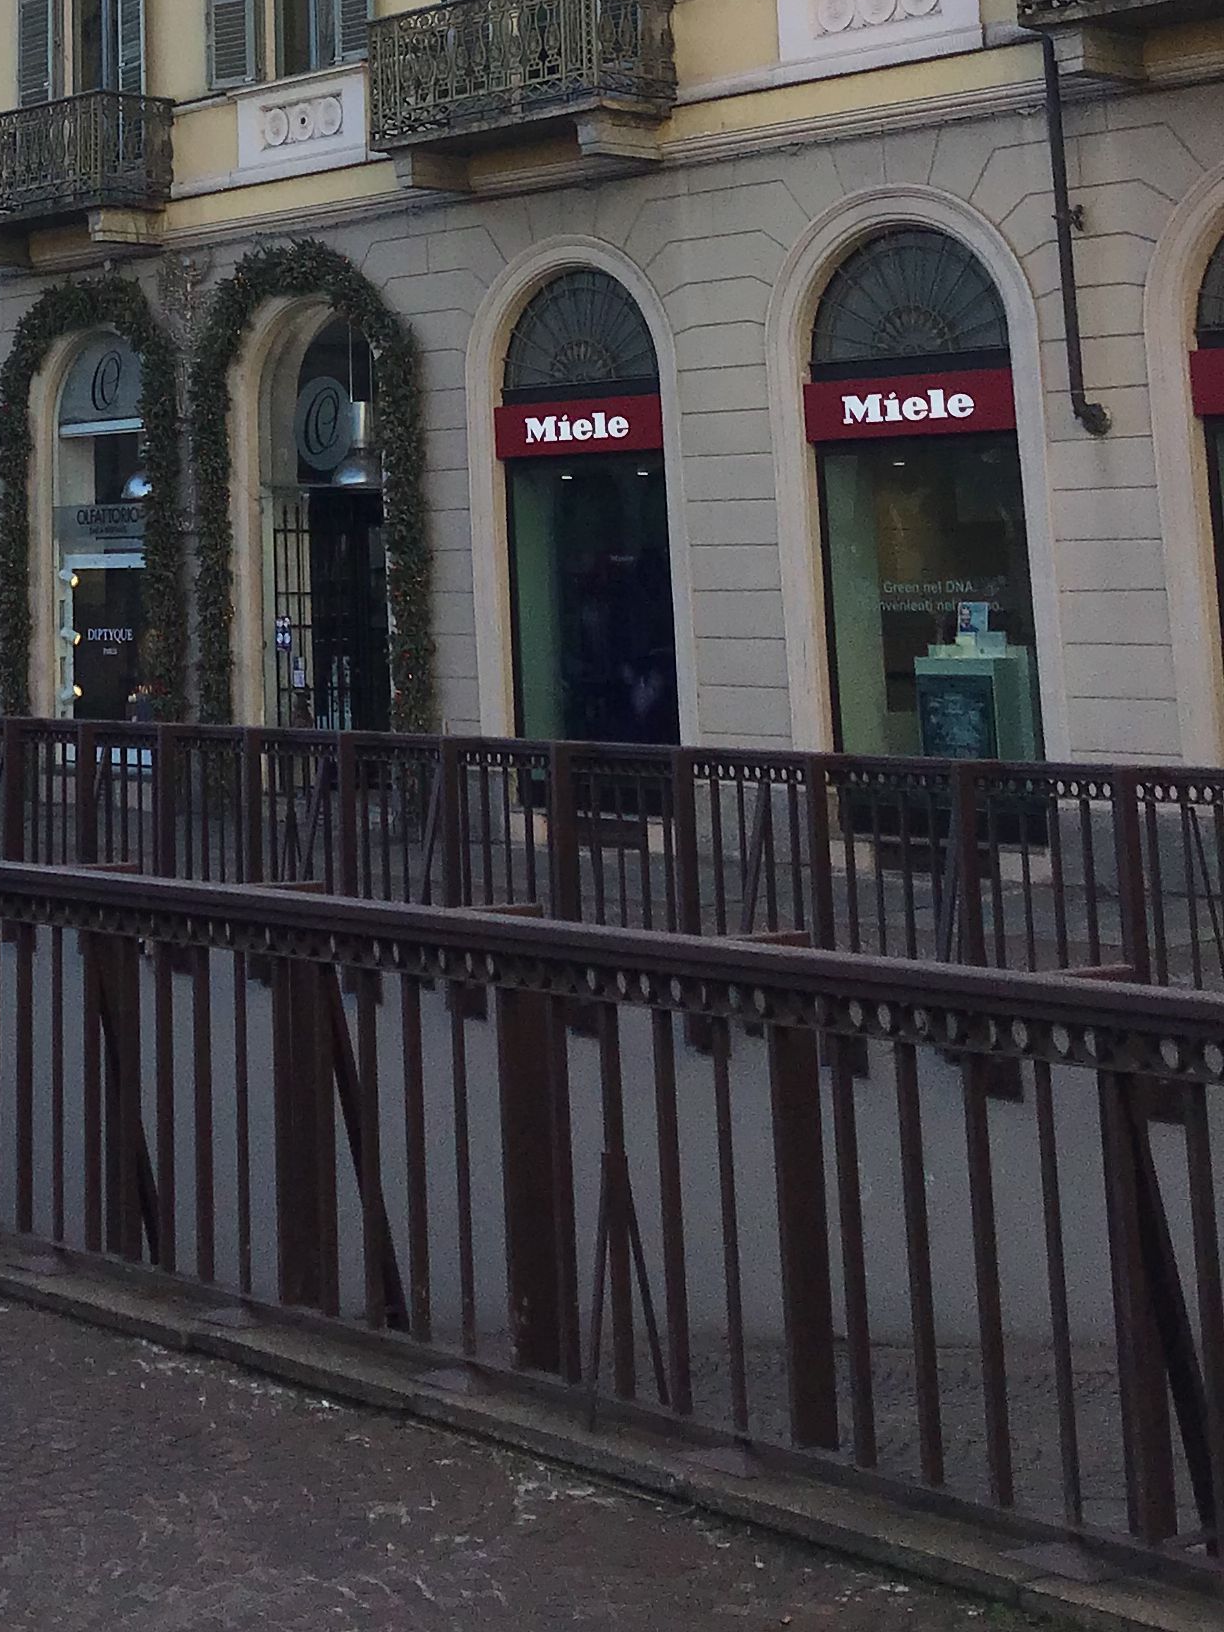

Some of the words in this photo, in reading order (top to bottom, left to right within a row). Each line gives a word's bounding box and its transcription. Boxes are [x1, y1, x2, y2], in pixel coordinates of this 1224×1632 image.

[841, 388, 975, 425] Miele
[524, 411, 630, 443] Miele
[77, 507, 139, 525] OLFATTORIO
[883, 580, 919, 593] Green
[923, 580, 942, 593] nel
[87, 628, 134, 644] DIPTYQUE
